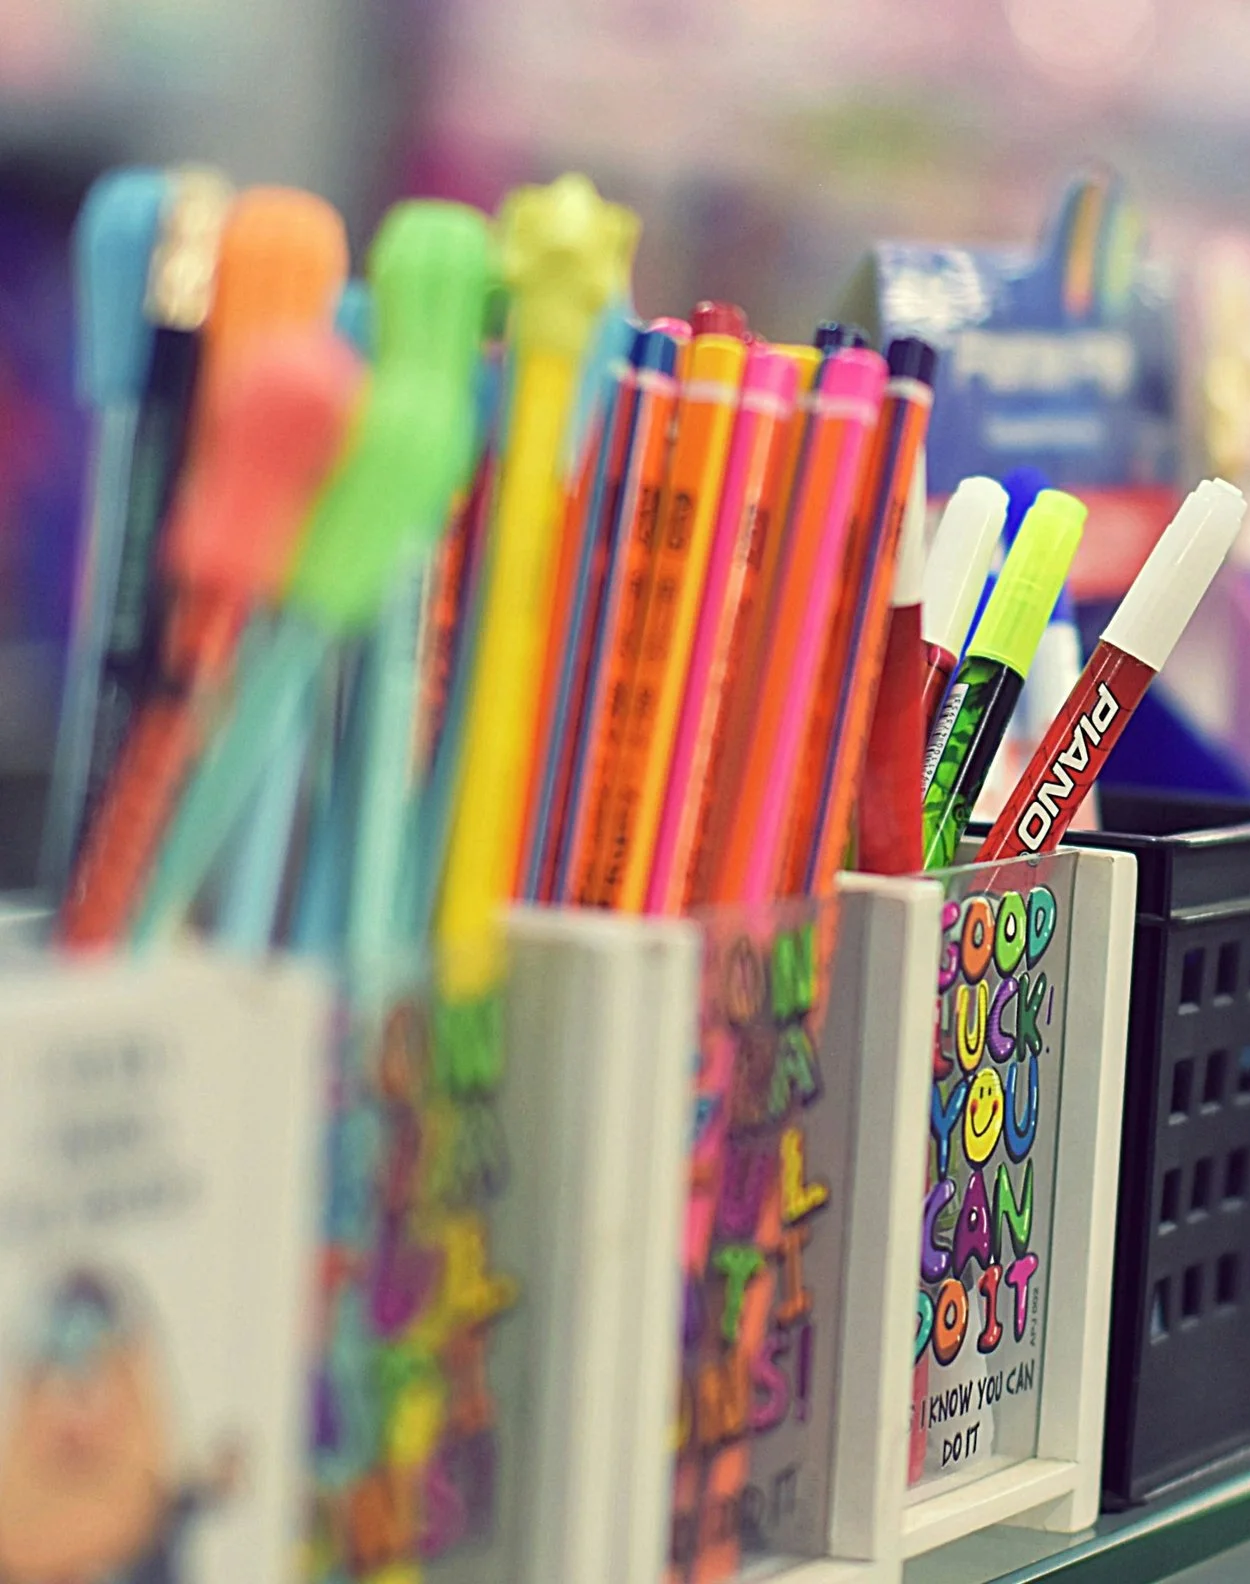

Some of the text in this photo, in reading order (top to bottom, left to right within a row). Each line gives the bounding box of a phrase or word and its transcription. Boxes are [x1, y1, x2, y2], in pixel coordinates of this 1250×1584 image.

[1017, 680, 1121, 853] PIANO
[931, 1056, 1039, 1182] YOU
[921, 1158, 1034, 1284] CAN
[913, 1253, 1039, 1366] DO IT
[928, 1380, 973, 1429] KNOW
[977, 1371, 1003, 1411] YOU
[1006, 1358, 1035, 1395] CAN
[941, 1421, 980, 1467] DO IT
